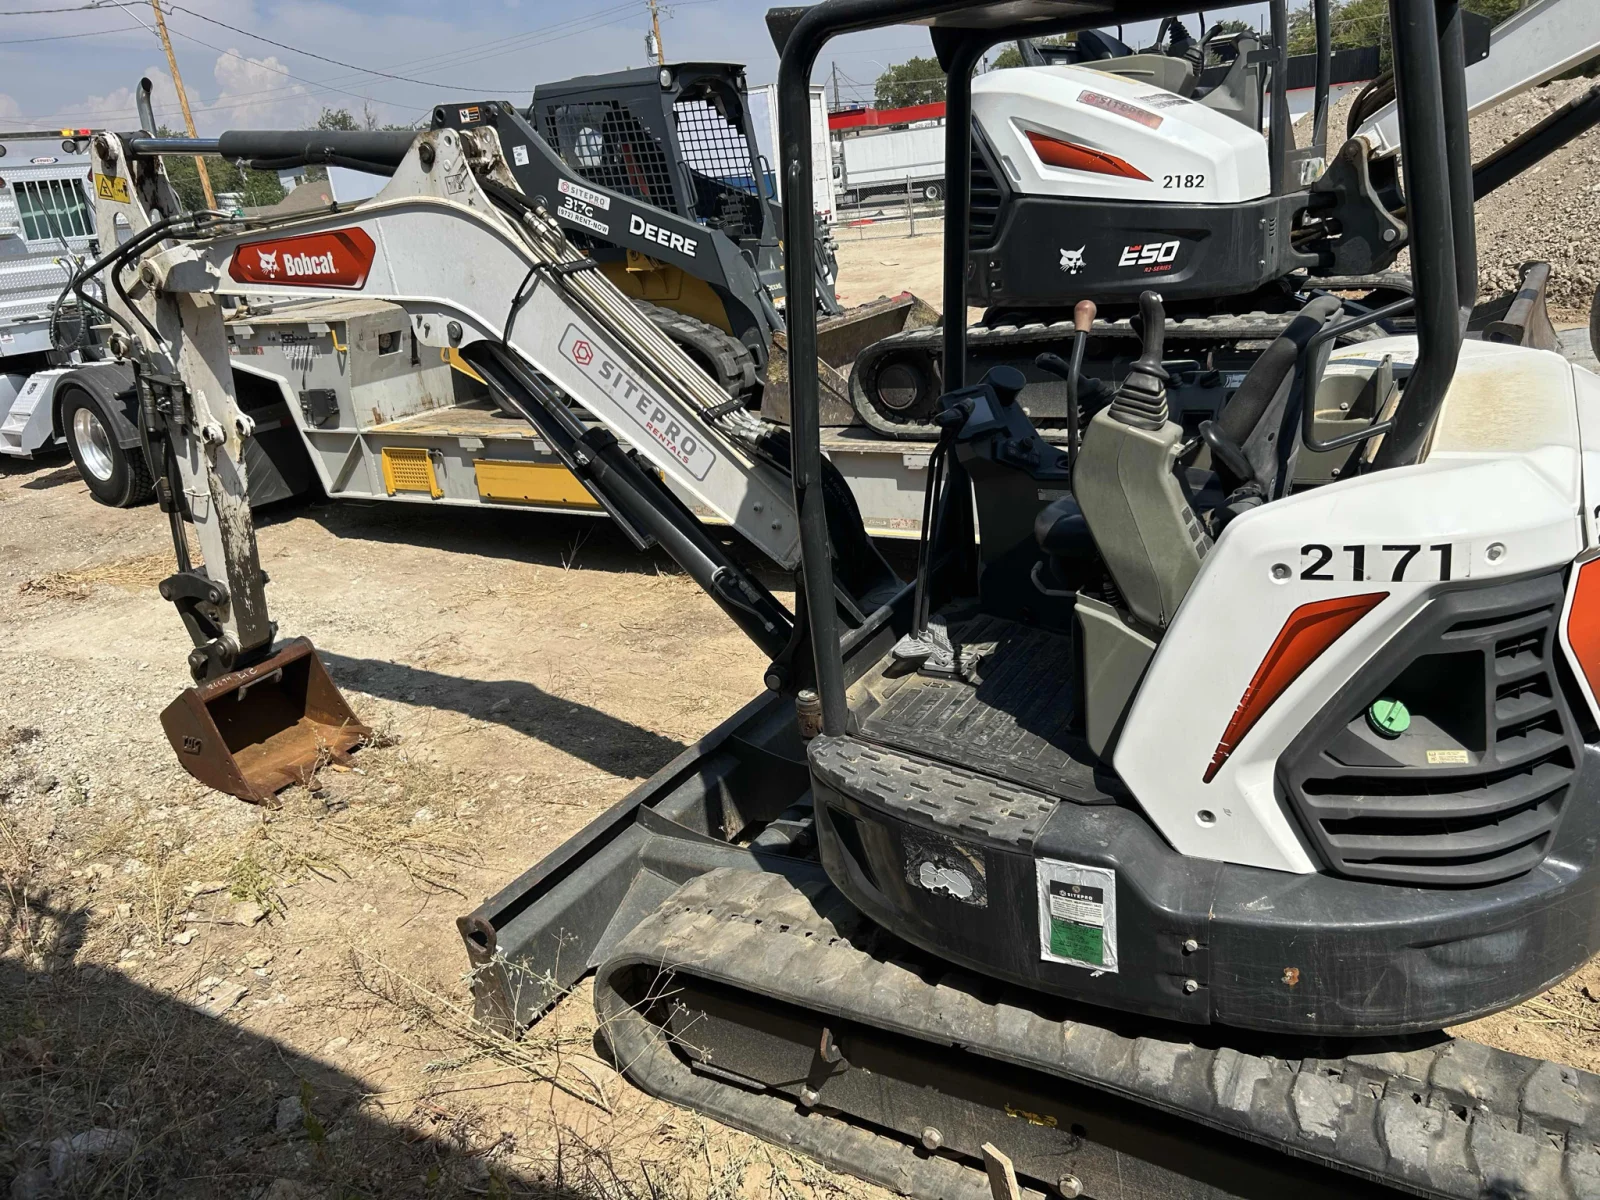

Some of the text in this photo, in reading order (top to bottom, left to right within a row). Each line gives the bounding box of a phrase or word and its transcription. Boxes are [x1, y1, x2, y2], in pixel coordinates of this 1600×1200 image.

[1163, 174, 1205, 188] 2182
[564, 196, 594, 217] 317G
[570, 186, 605, 206] SITEPRO
[558, 207, 608, 233] (972) RENT-NOW
[629, 214, 698, 257] DEERE
[282, 251, 336, 276] Bobcat
[1118, 240, 1180, 267] E50
[1144, 264, 1172, 273] R2-SERIES
[598, 360, 697, 457] SITEPRO
[645, 421, 690, 464] RENTALS
[1300, 543, 1453, 582] 2171
[1066, 892, 1093, 901] SITEPRO
